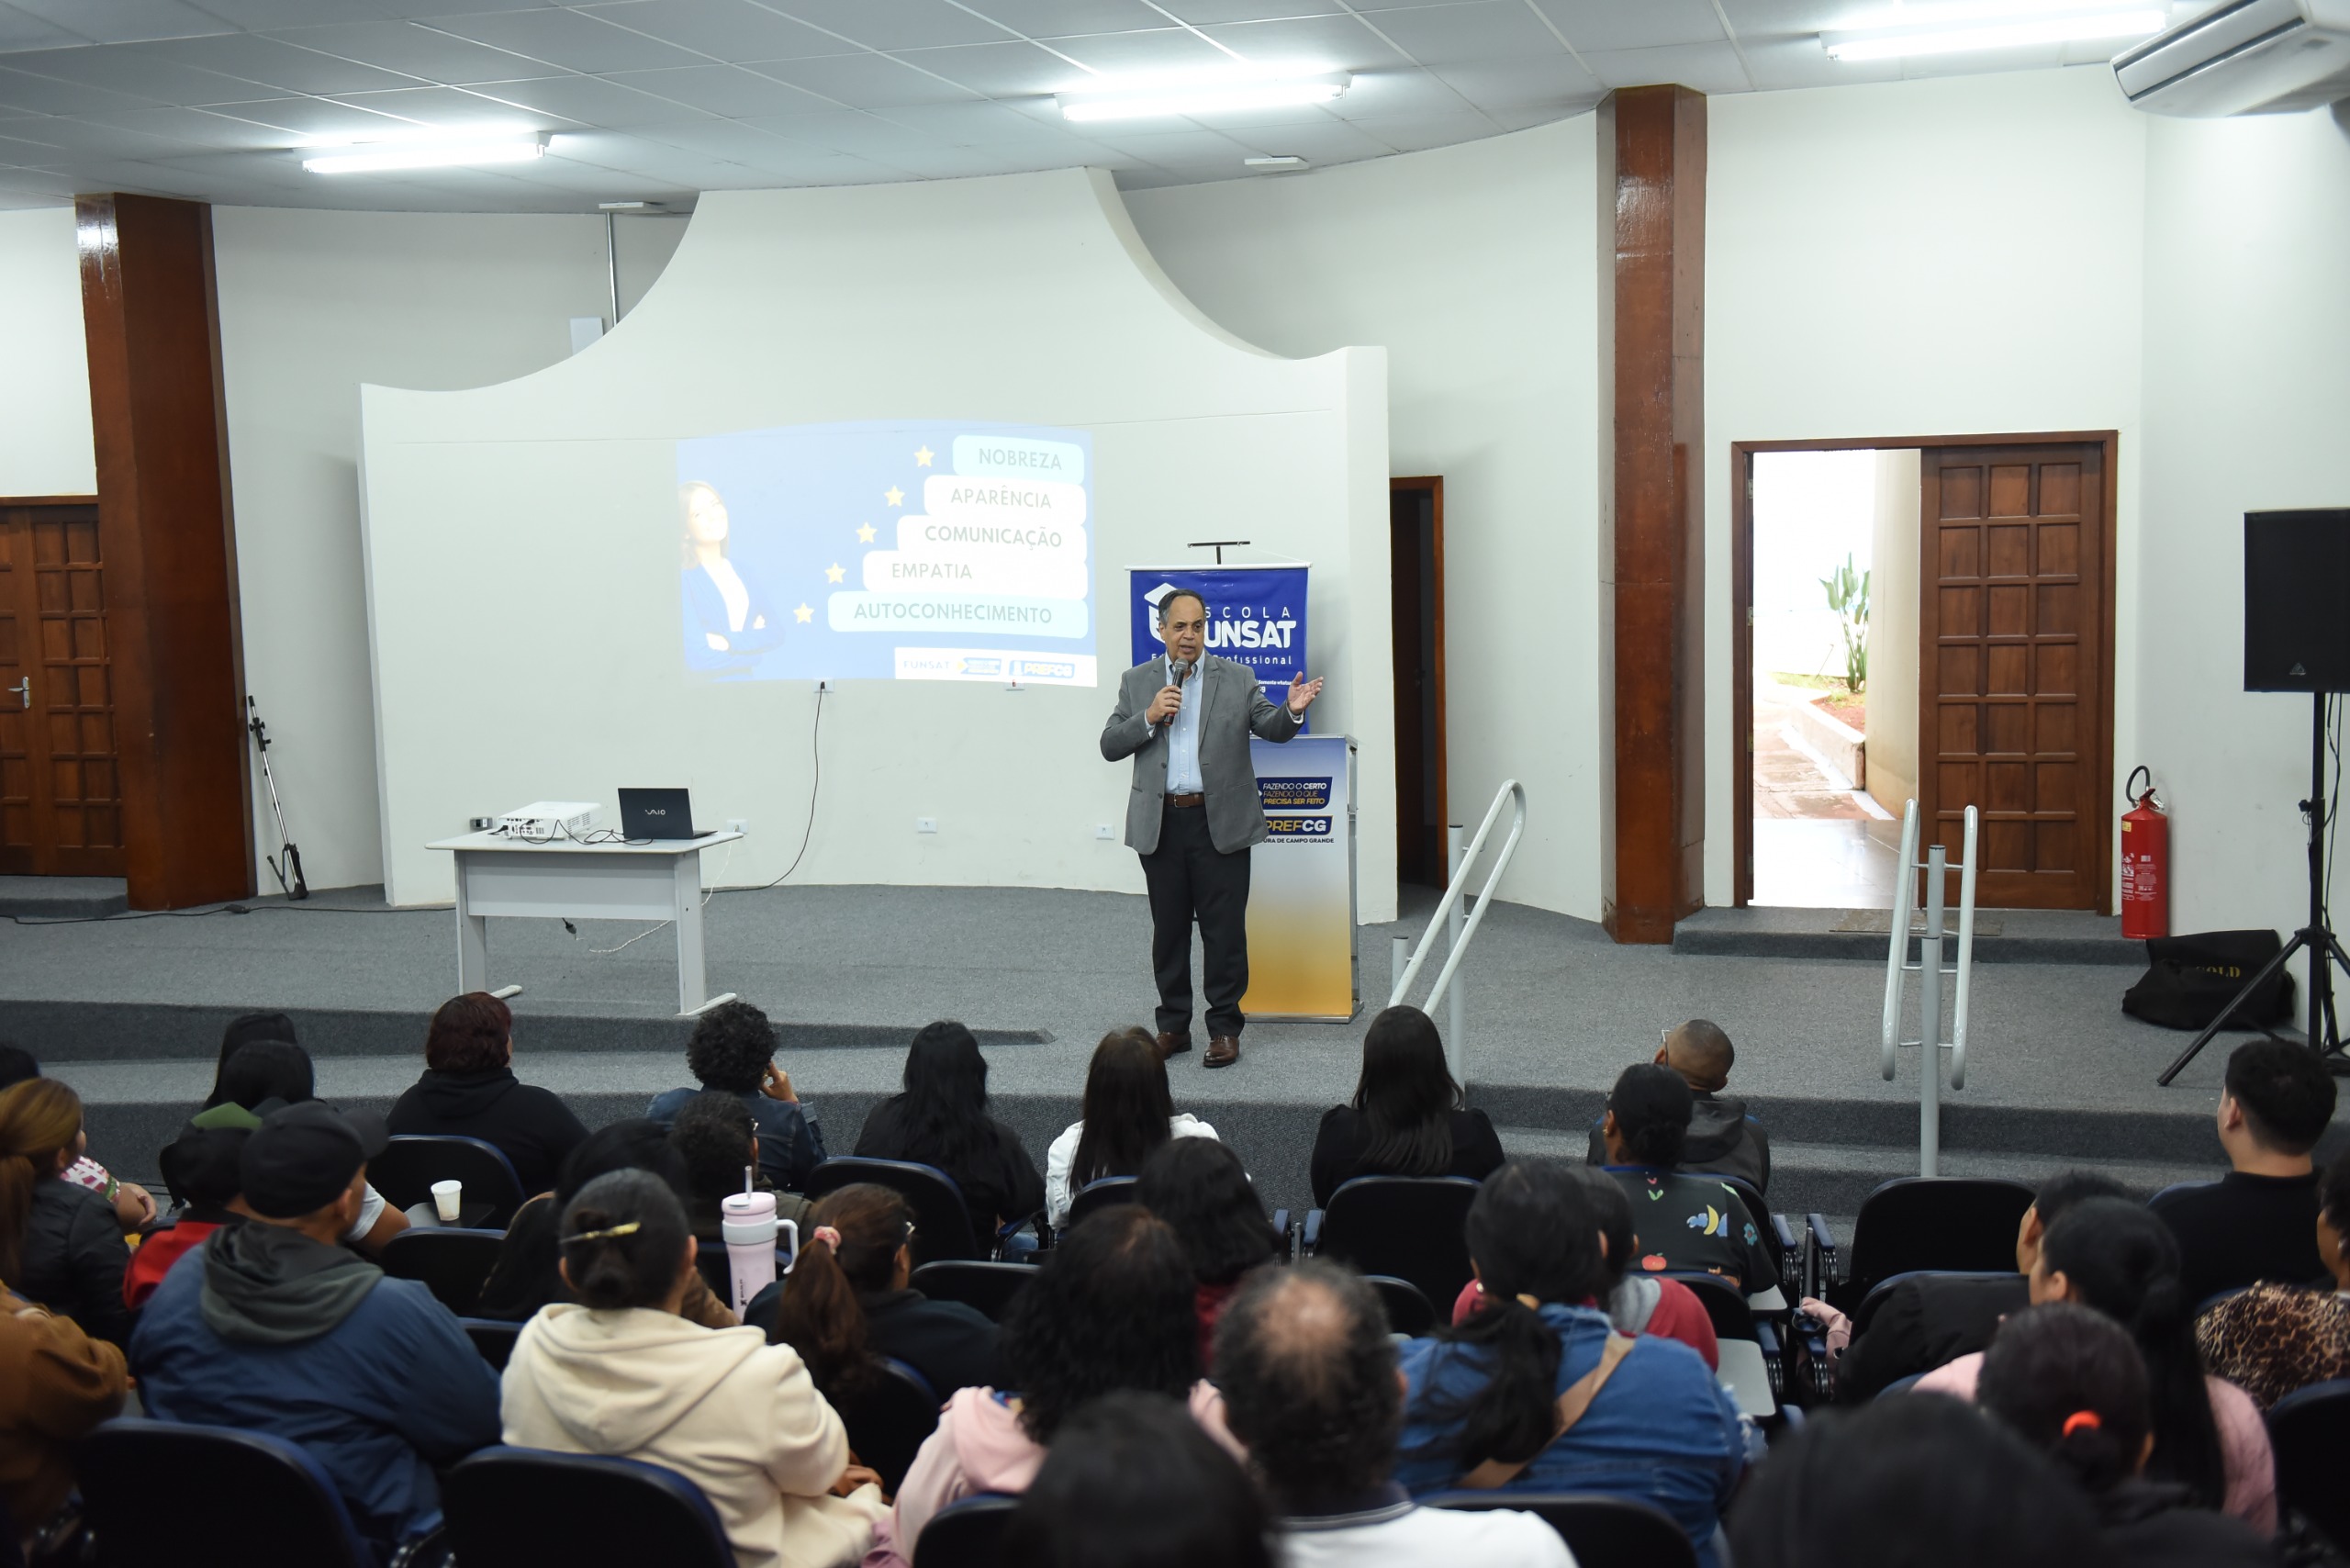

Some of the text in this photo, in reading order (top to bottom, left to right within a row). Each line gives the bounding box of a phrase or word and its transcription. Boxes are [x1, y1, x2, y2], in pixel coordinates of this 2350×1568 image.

[979, 448, 1062, 471] NOBREZA
[950, 484, 1052, 510] APARÊNCIA
[924, 525, 1062, 551] COMUNICAÇÃO
[891, 563, 973, 580] EMPATIA
[854, 602, 1053, 624] AUTOCONHECIMENTO
[1204, 607, 1291, 619] SCOLA
[1203, 620, 1297, 649] UNSAT
[903, 660, 951, 670] FUNSAT
